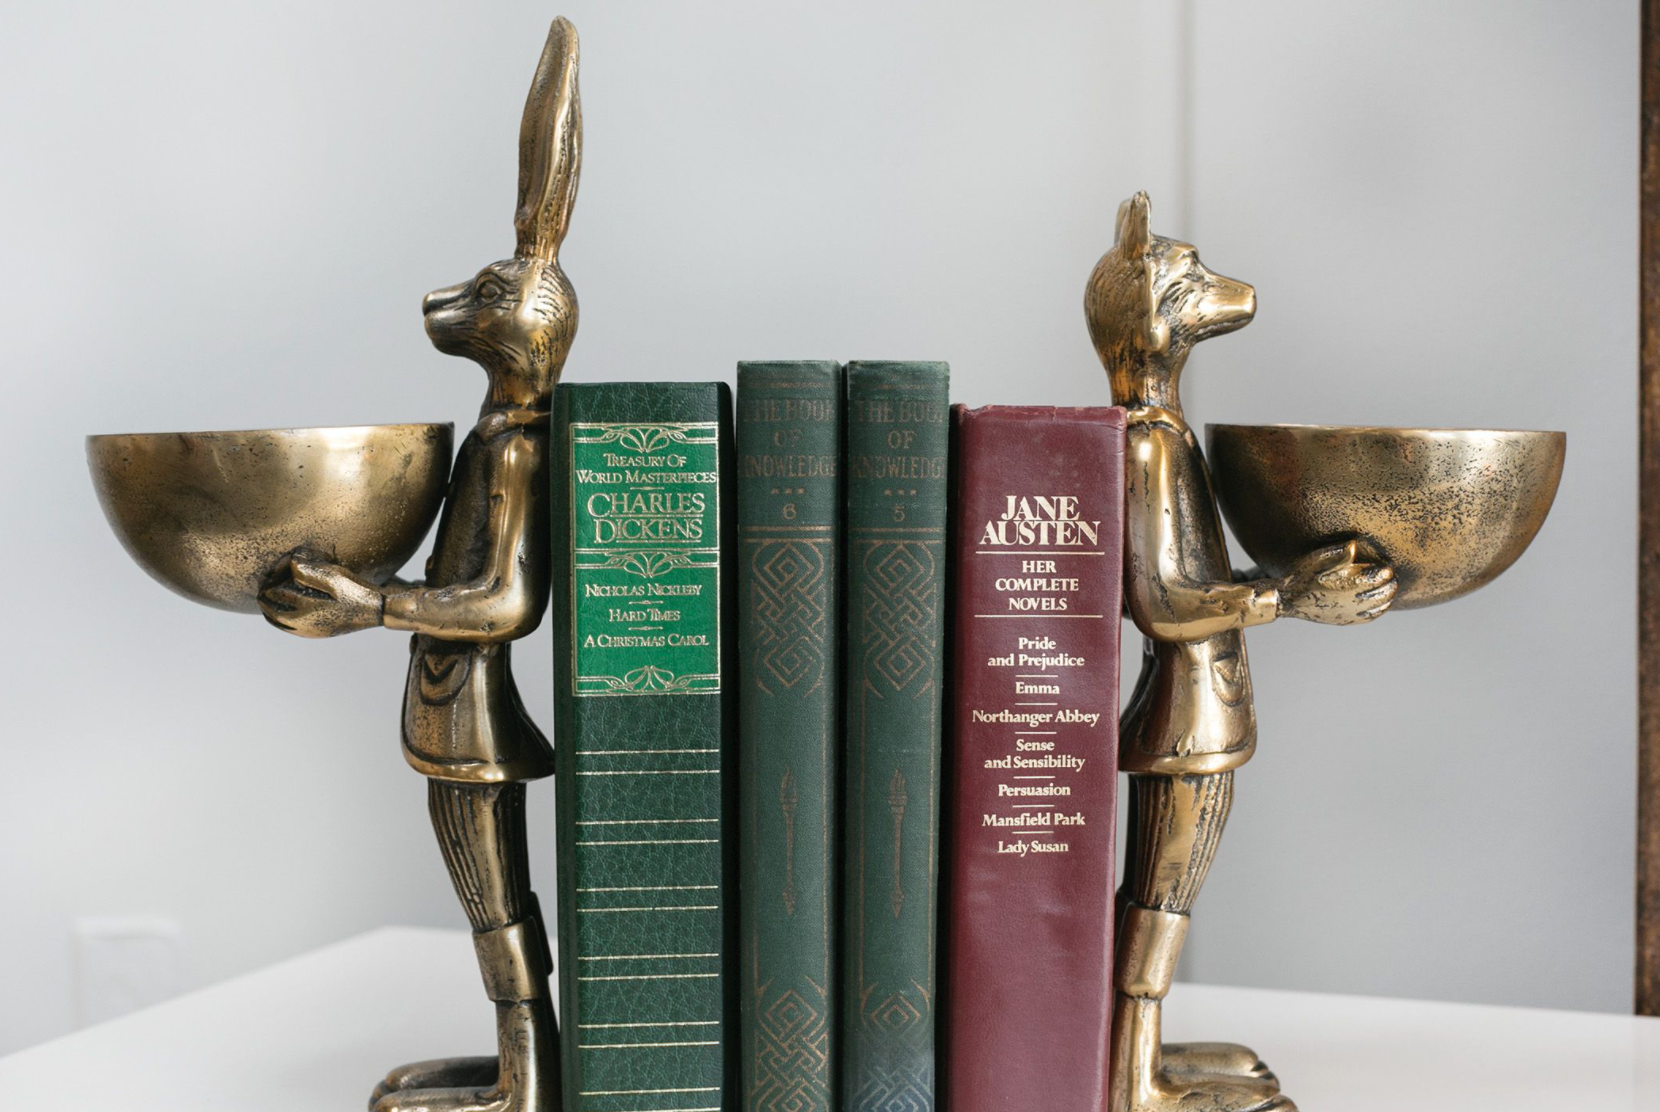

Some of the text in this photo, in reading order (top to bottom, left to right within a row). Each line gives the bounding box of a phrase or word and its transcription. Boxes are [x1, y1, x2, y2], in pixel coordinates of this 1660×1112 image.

[887, 430, 918, 450] OF
[603, 453, 687, 467] TREASURY OF
[852, 456, 947, 479] KNOWLEDG
[576, 470, 716, 484] WORLD MASTERPIECES
[587, 493, 706, 518] CHARLES
[782, 503, 798, 520] 6
[1001, 495, 1080, 521] JANE
[893, 505, 907, 522] 5
[594, 519, 703, 544] DICKENS
[979, 520, 1101, 546] AUSTEN
[1022, 560, 1057, 573] HER
[585, 583, 702, 598] NICHOLAS NICKLEBY
[995, 578, 1079, 591] COMPLETE
[1008, 598, 1068, 611] NOVELS
[609, 609, 681, 623] HARD TIMES
[584, 634, 710, 648] A CHRISTMAS CAROL
[1018, 637, 1057, 650] Pride
[987, 654, 1086, 671] and Prejudice
[1015, 682, 1060, 694] Emma
[972, 710, 1100, 727] Northanger Abbey
[1016, 739, 1055, 751] Sense
[984, 756, 1086, 772] and Sensibility
[998, 783, 1071, 797] Persuasion
[982, 813, 1086, 827] Mansfield Park
[997, 841, 1069, 857] Lady Susan
